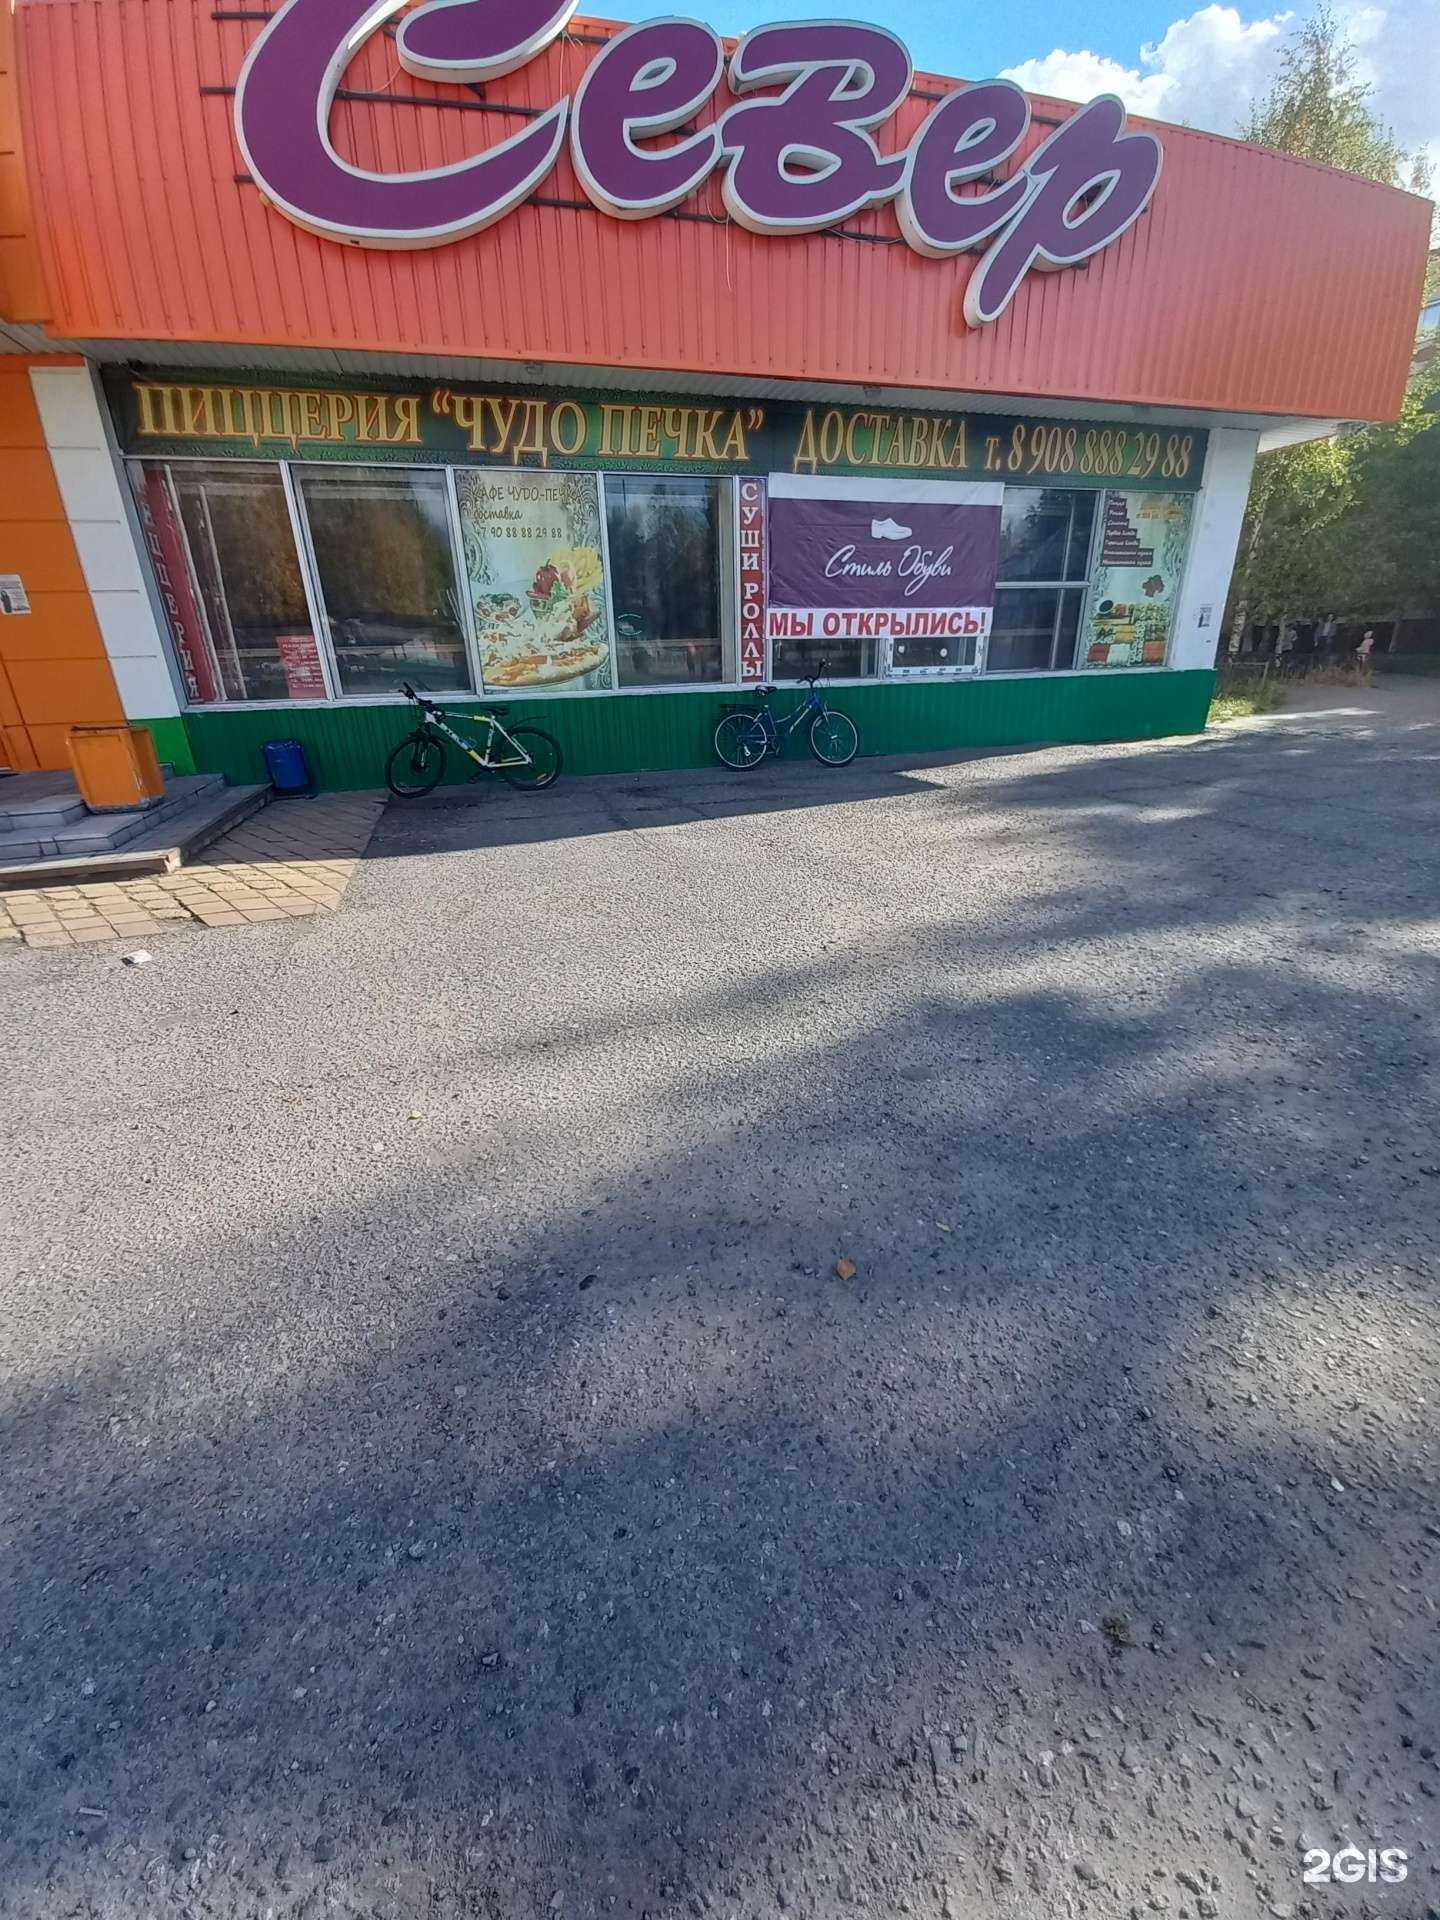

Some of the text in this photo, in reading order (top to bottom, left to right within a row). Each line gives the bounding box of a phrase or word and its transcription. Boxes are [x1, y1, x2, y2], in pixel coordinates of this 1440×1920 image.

[234, 0, 1165, 328] Север
[135, 383, 422, 451] ПИЦЦЕРИЯ
[793, 408, 969, 474] ДОСТАВКА
[1007, 424, 1026, 471] 8
[1027, 425, 1077, 474] 908
[1080, 429, 1127, 475] 888
[1127, 431, 1160, 479] 29
[1161, 434, 1193, 478] 88
[472, 486, 505, 501] КАФЕ
[490, 527, 503, 538] 90
[505, 527, 518, 538] 88
[521, 527, 533, 538] 88
[535, 527, 548, 538] 29
[551, 527, 563, 538] 88
[741, 482, 764, 677] СУШИ РОЛЛЫ
[825, 545, 954, 597] Стиль Обуви
[769, 612, 987, 637] МЫ ОТКРЫЛИСЬ!
